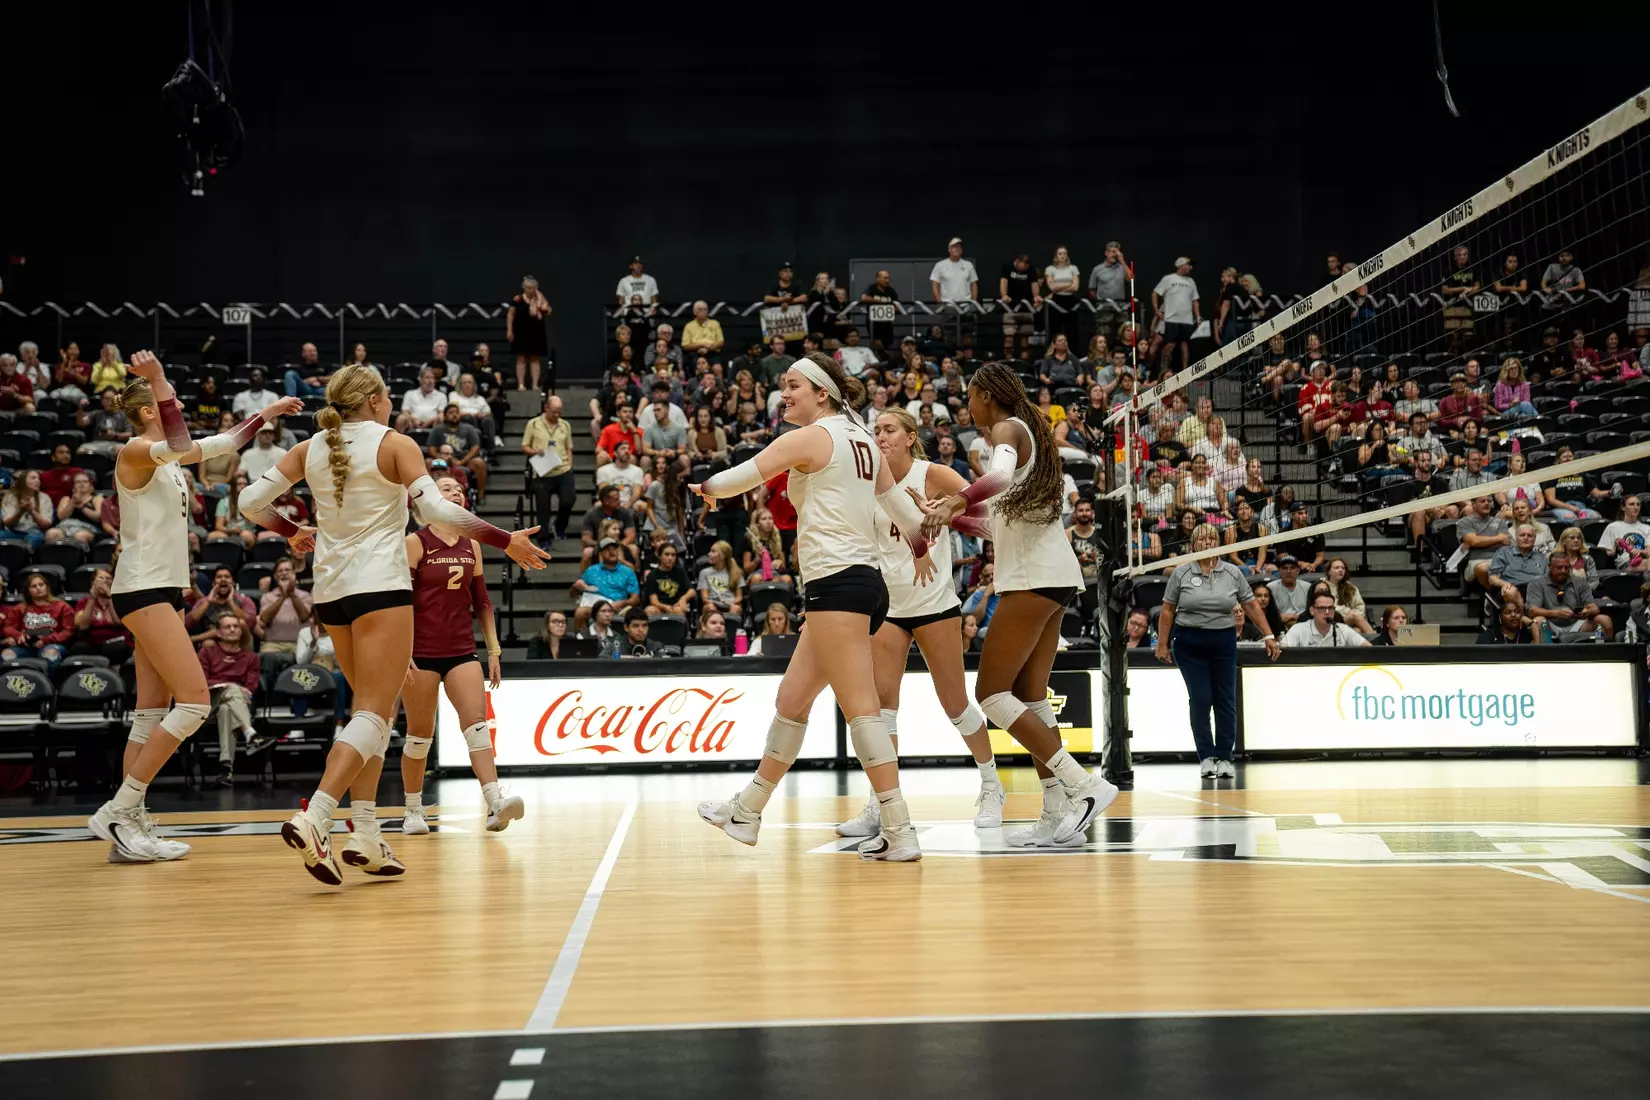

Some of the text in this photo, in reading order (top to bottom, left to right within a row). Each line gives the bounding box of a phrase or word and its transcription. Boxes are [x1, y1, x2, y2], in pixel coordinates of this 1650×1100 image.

[1548, 128, 1590, 169] KNIGHTS
[1441, 199, 1473, 233] KNIGHTS
[1357, 253, 1384, 281] KNIGHTS
[224, 309, 248, 322] 107
[871, 306, 894, 319] 108
[1291, 296, 1313, 320] KNIGHTS
[1475, 296, 1499, 310] 109
[848, 439, 874, 481] 10
[181, 491, 187, 517] 9
[890, 521, 901, 542] 4
[427, 557, 459, 565] FLORIDA
[447, 565, 464, 590] 2
[1352, 686, 1536, 727] fbc mortgage
[534, 687, 745, 757] Coca-Cola
